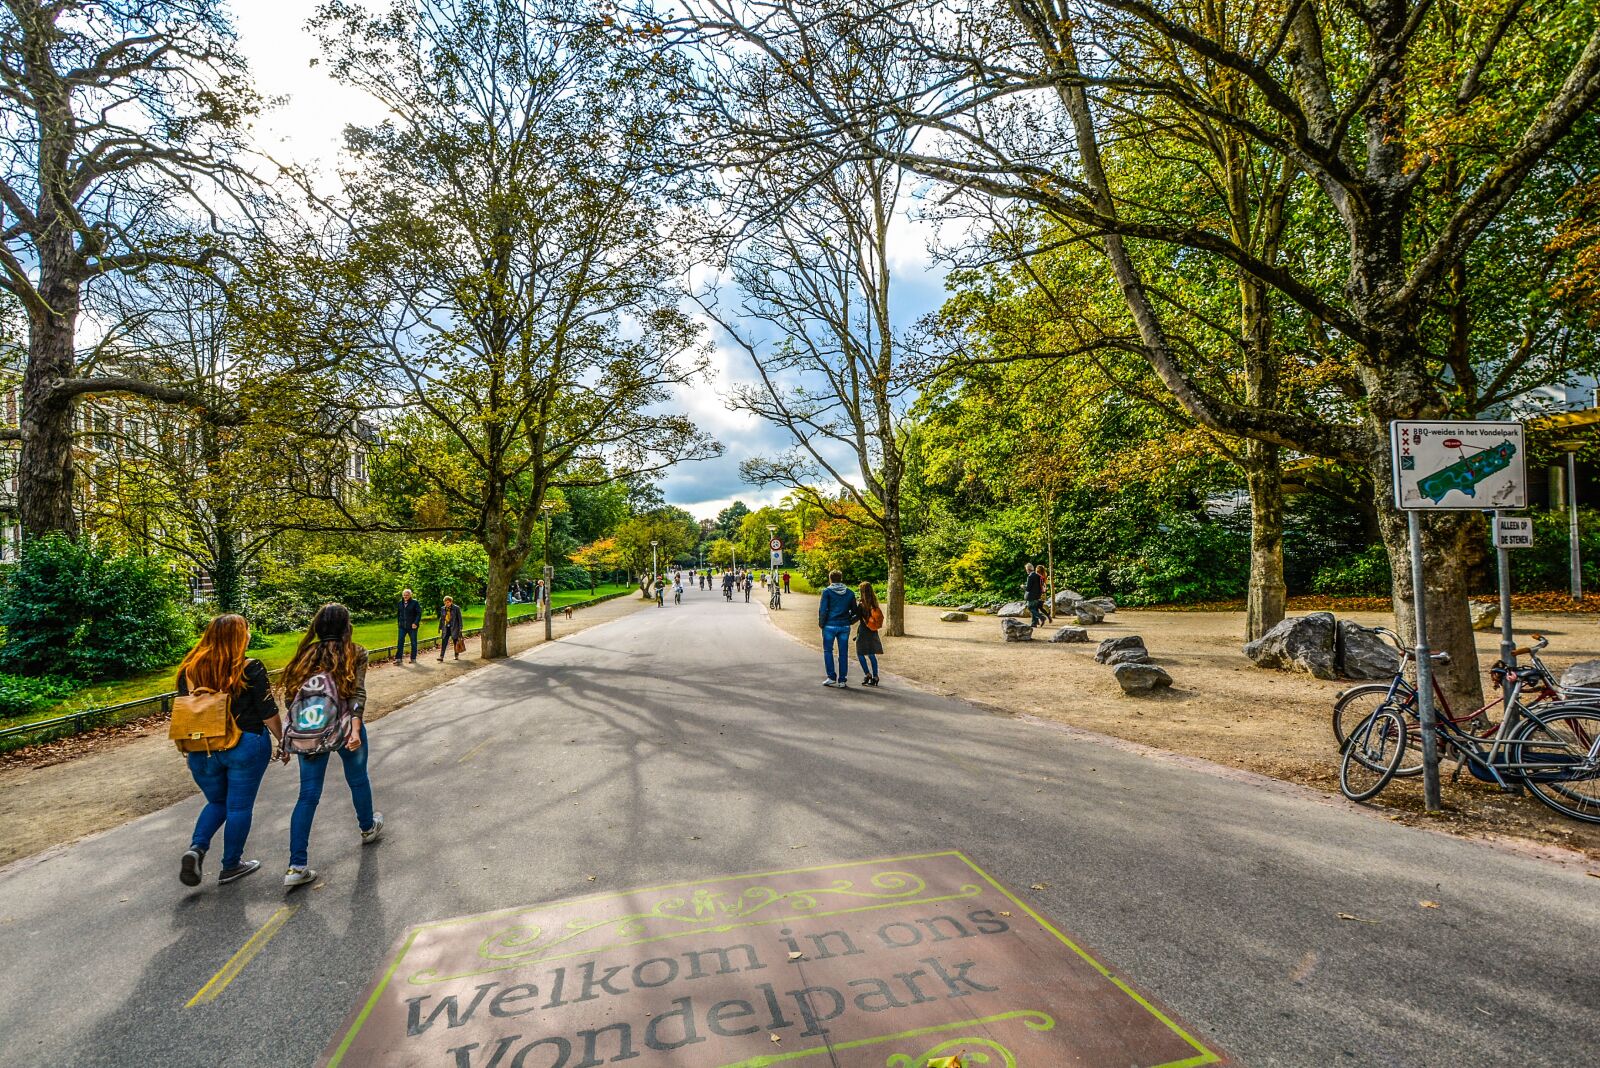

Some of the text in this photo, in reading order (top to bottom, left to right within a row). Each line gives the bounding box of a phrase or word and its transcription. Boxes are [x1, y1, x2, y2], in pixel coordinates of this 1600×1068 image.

[1413, 428, 1519, 437] BBQ-weides in het Vondelpark
[1501, 521, 1528, 530] ALLEEN OP
[1501, 535, 1529, 545] DE STENEN
[405, 909, 1010, 1036] Welkom in ons
